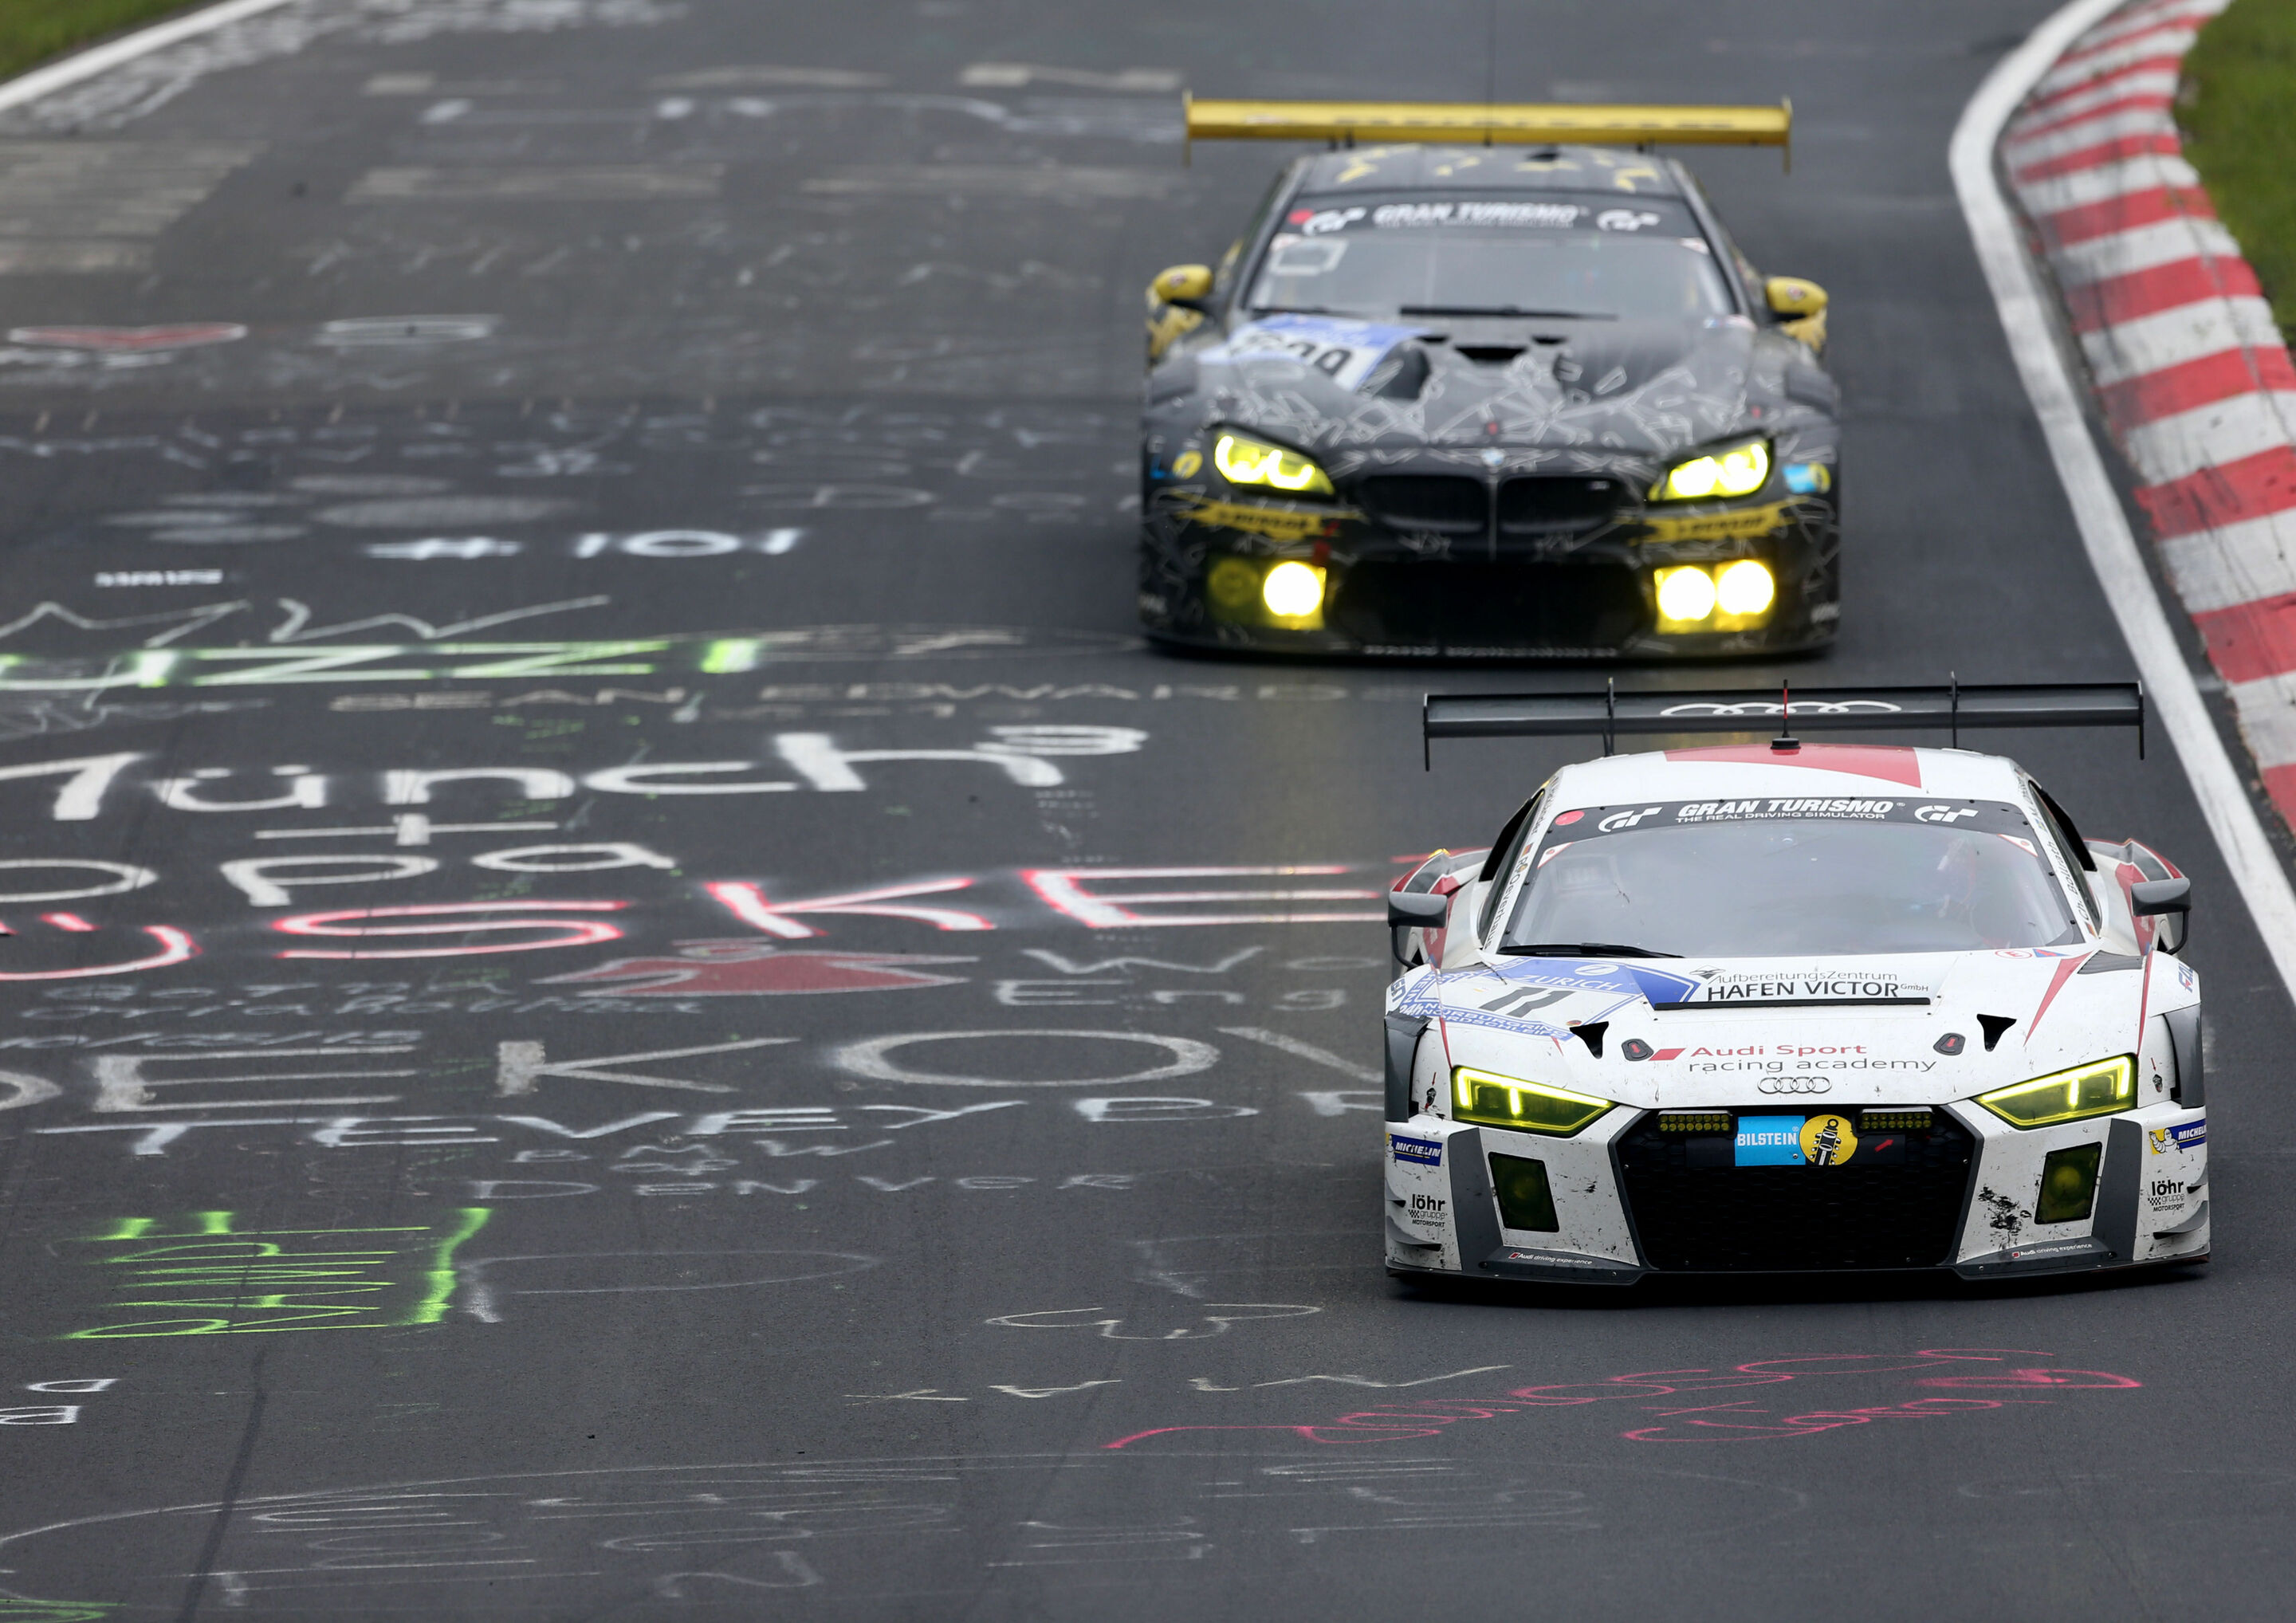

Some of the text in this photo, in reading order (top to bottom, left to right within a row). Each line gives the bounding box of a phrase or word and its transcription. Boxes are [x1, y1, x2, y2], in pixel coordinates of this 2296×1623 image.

[1372, 202, 1579, 224] GRAN TURISMO
[1678, 799, 1894, 818] GRAN TURISMO
[1519, 974, 1624, 992] ZURICH
[1708, 981, 1929, 1001] HAFEN VICTOR GmbH
[1478, 986, 1577, 1018] 11
[1690, 1044, 1868, 1058] Audi Sport
[1689, 1058, 1937, 1073] racing academy
[1736, 1132, 1798, 1146] BILSTEIN
[508, 1138, 897, 1164] BMW
[1395, 1142, 1442, 1157] MICHELIN
[2151, 1180, 2184, 1197] löhr
[1412, 1193, 1446, 1212] löhr
[2161, 1194, 2185, 1205] gruppe
[1420, 1210, 1446, 1220] gruppe
[2152, 1204, 2185, 1212] MOTORSPORT
[1412, 1219, 1445, 1228] MOTORSPORT
